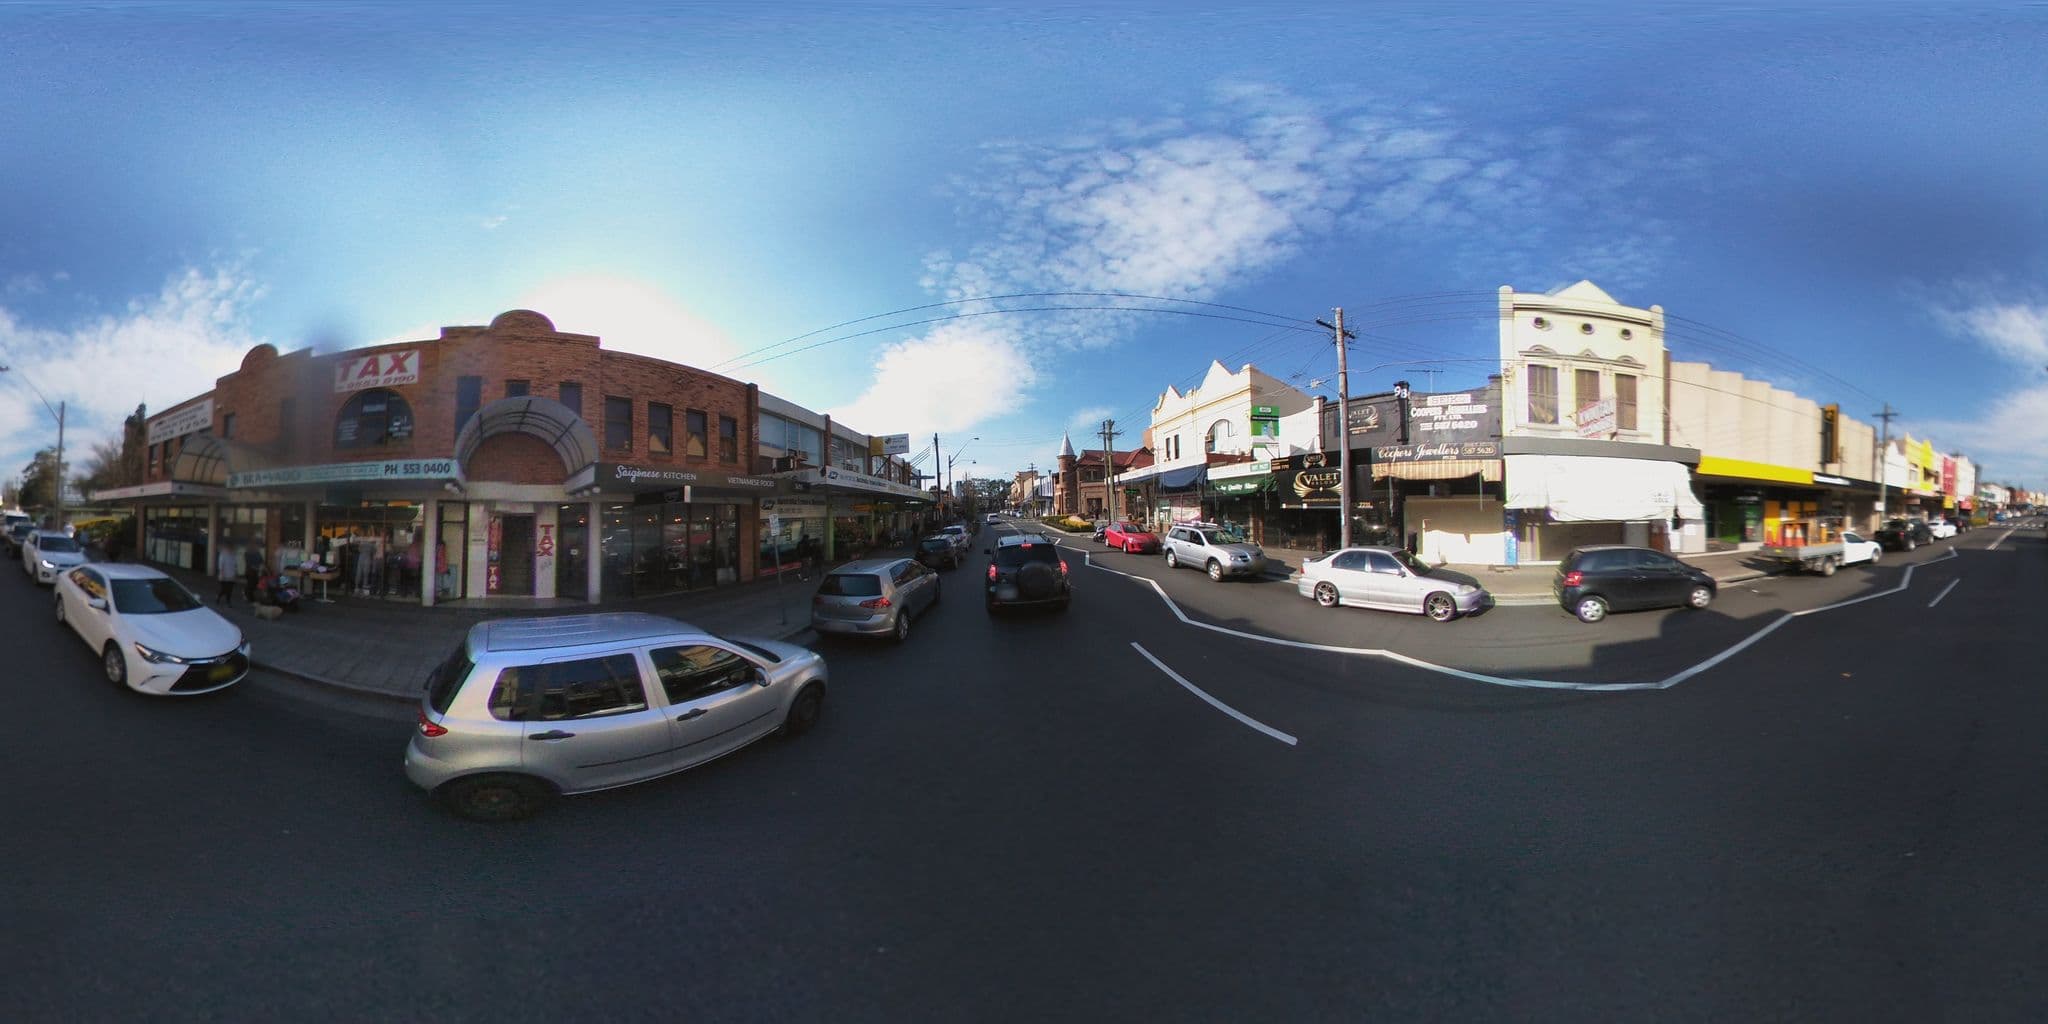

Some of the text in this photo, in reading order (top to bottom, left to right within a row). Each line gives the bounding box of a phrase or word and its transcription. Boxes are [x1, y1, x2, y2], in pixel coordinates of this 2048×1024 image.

[338, 352, 414, 380] TAX
[1394, 385, 1408, 399] 98
[1414, 442, 1459, 460] Jewellers
[384, 464, 398, 475] PH
[423, 462, 450, 473] 0400
[663, 471, 696, 480] KITCHEN
[1303, 472, 1339, 485] VALET
[536, 524, 555, 557] TAX
[488, 565, 497, 590] TAX
